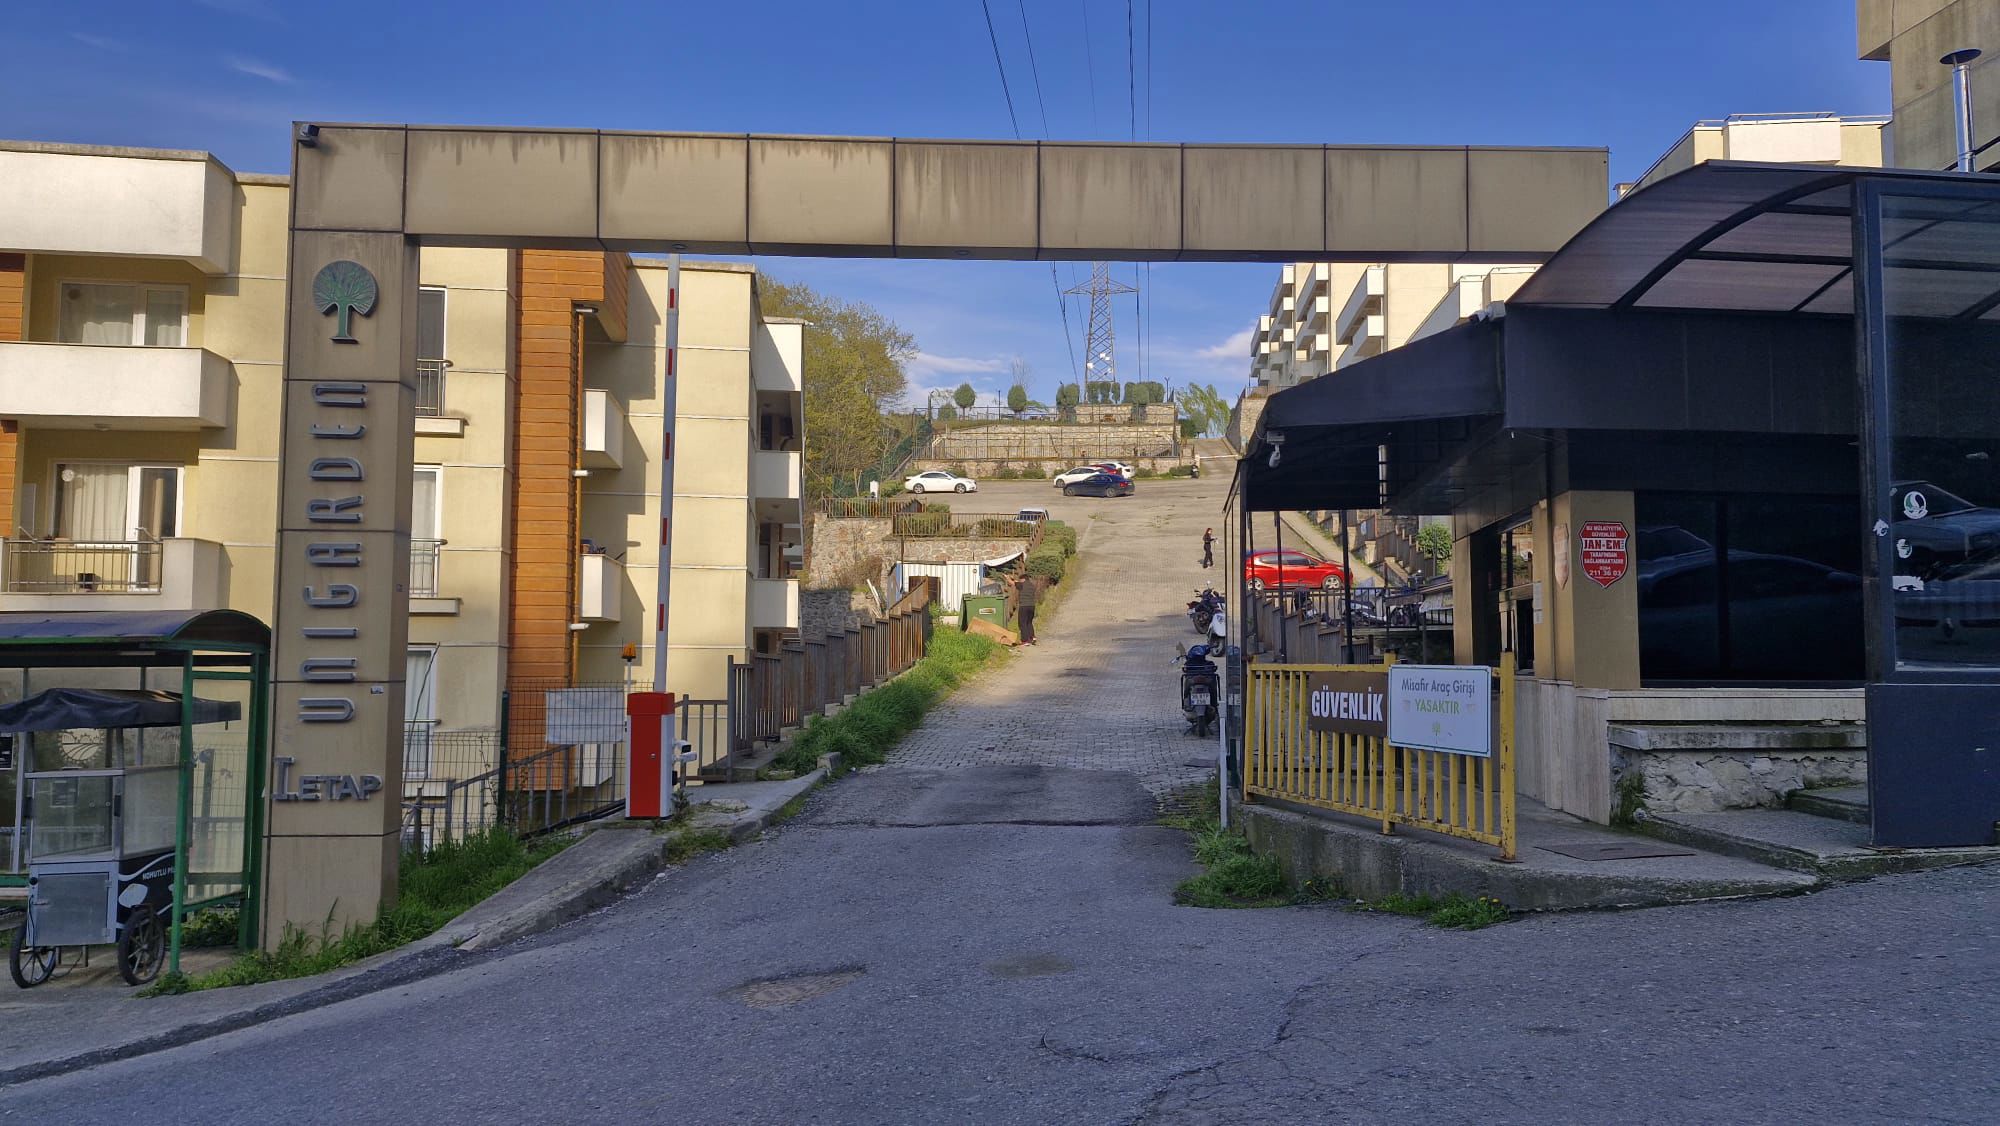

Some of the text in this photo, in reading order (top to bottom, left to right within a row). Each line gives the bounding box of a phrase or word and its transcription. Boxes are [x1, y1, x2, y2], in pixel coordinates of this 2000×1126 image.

[1401, 677, 1475, 698] Misafir Araç Girişi
[1311, 685, 1384, 722] GÜVENLİK
[1415, 698, 1460, 715] YASAKTIR
